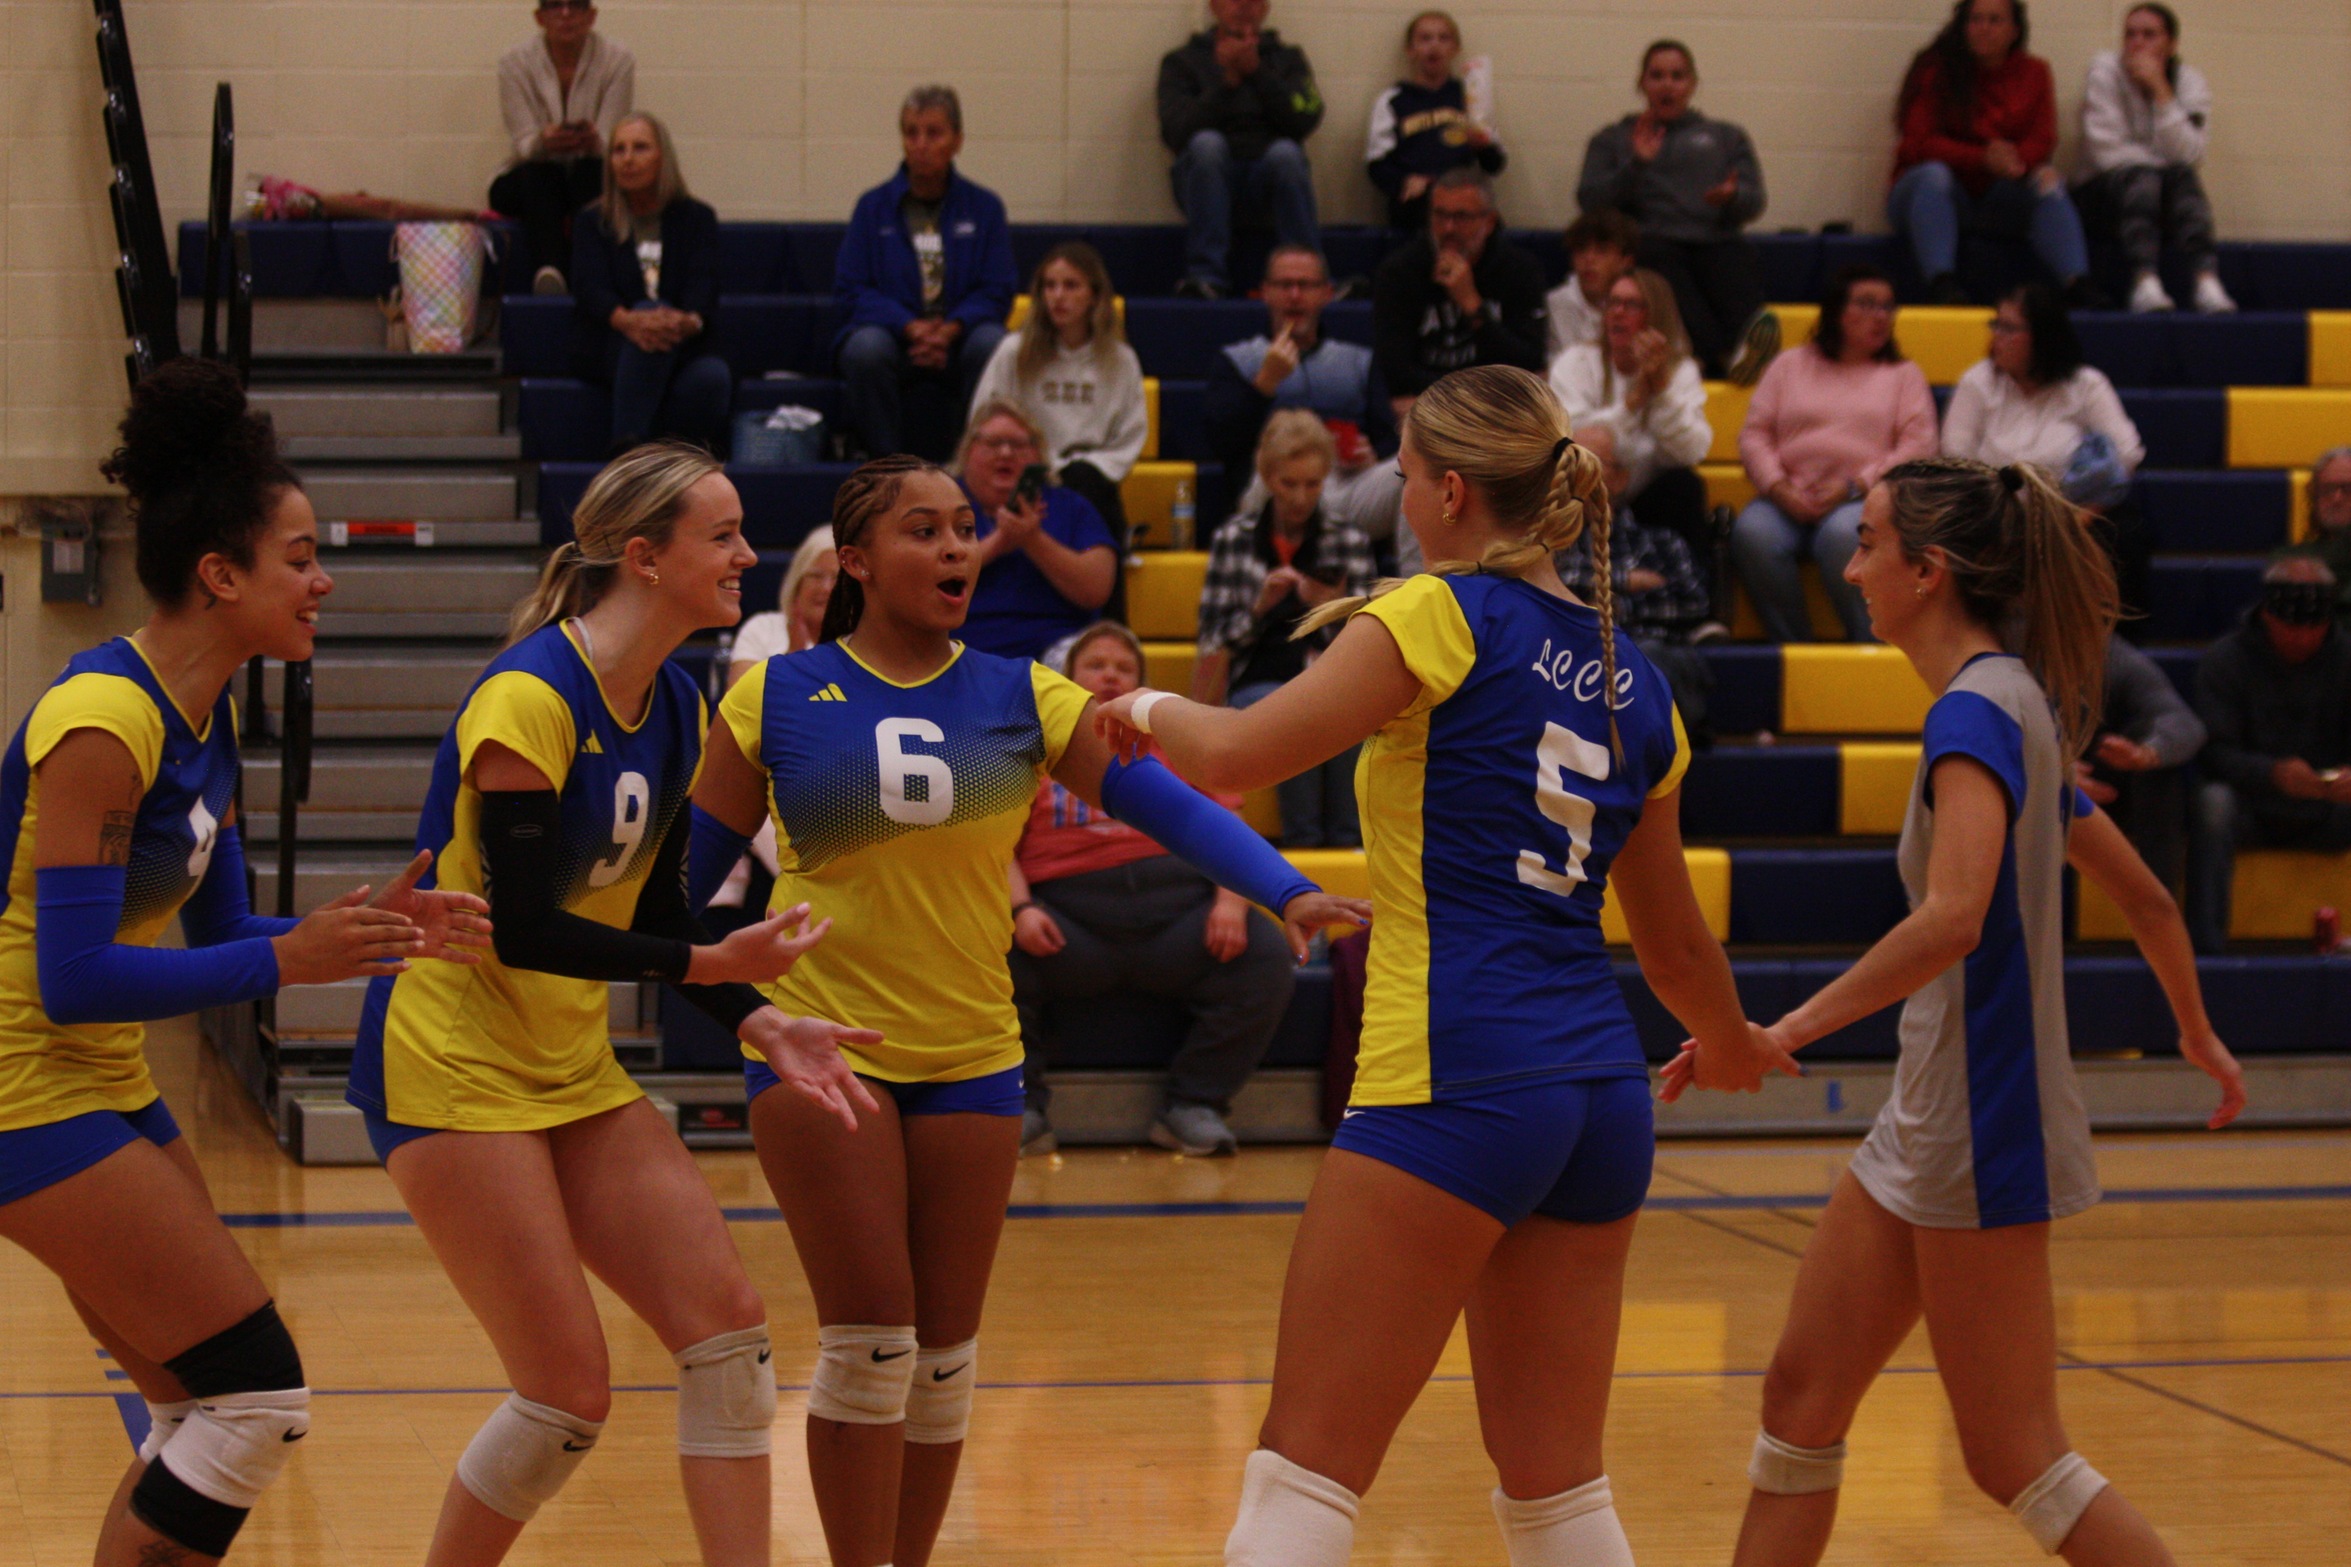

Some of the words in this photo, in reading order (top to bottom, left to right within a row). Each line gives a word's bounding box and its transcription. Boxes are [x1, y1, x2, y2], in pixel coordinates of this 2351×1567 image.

[1531, 638, 1635, 710] LCCC
[875, 717, 955, 826] 6
[1516, 721, 1610, 897] 5
[588, 771, 649, 887] 9
